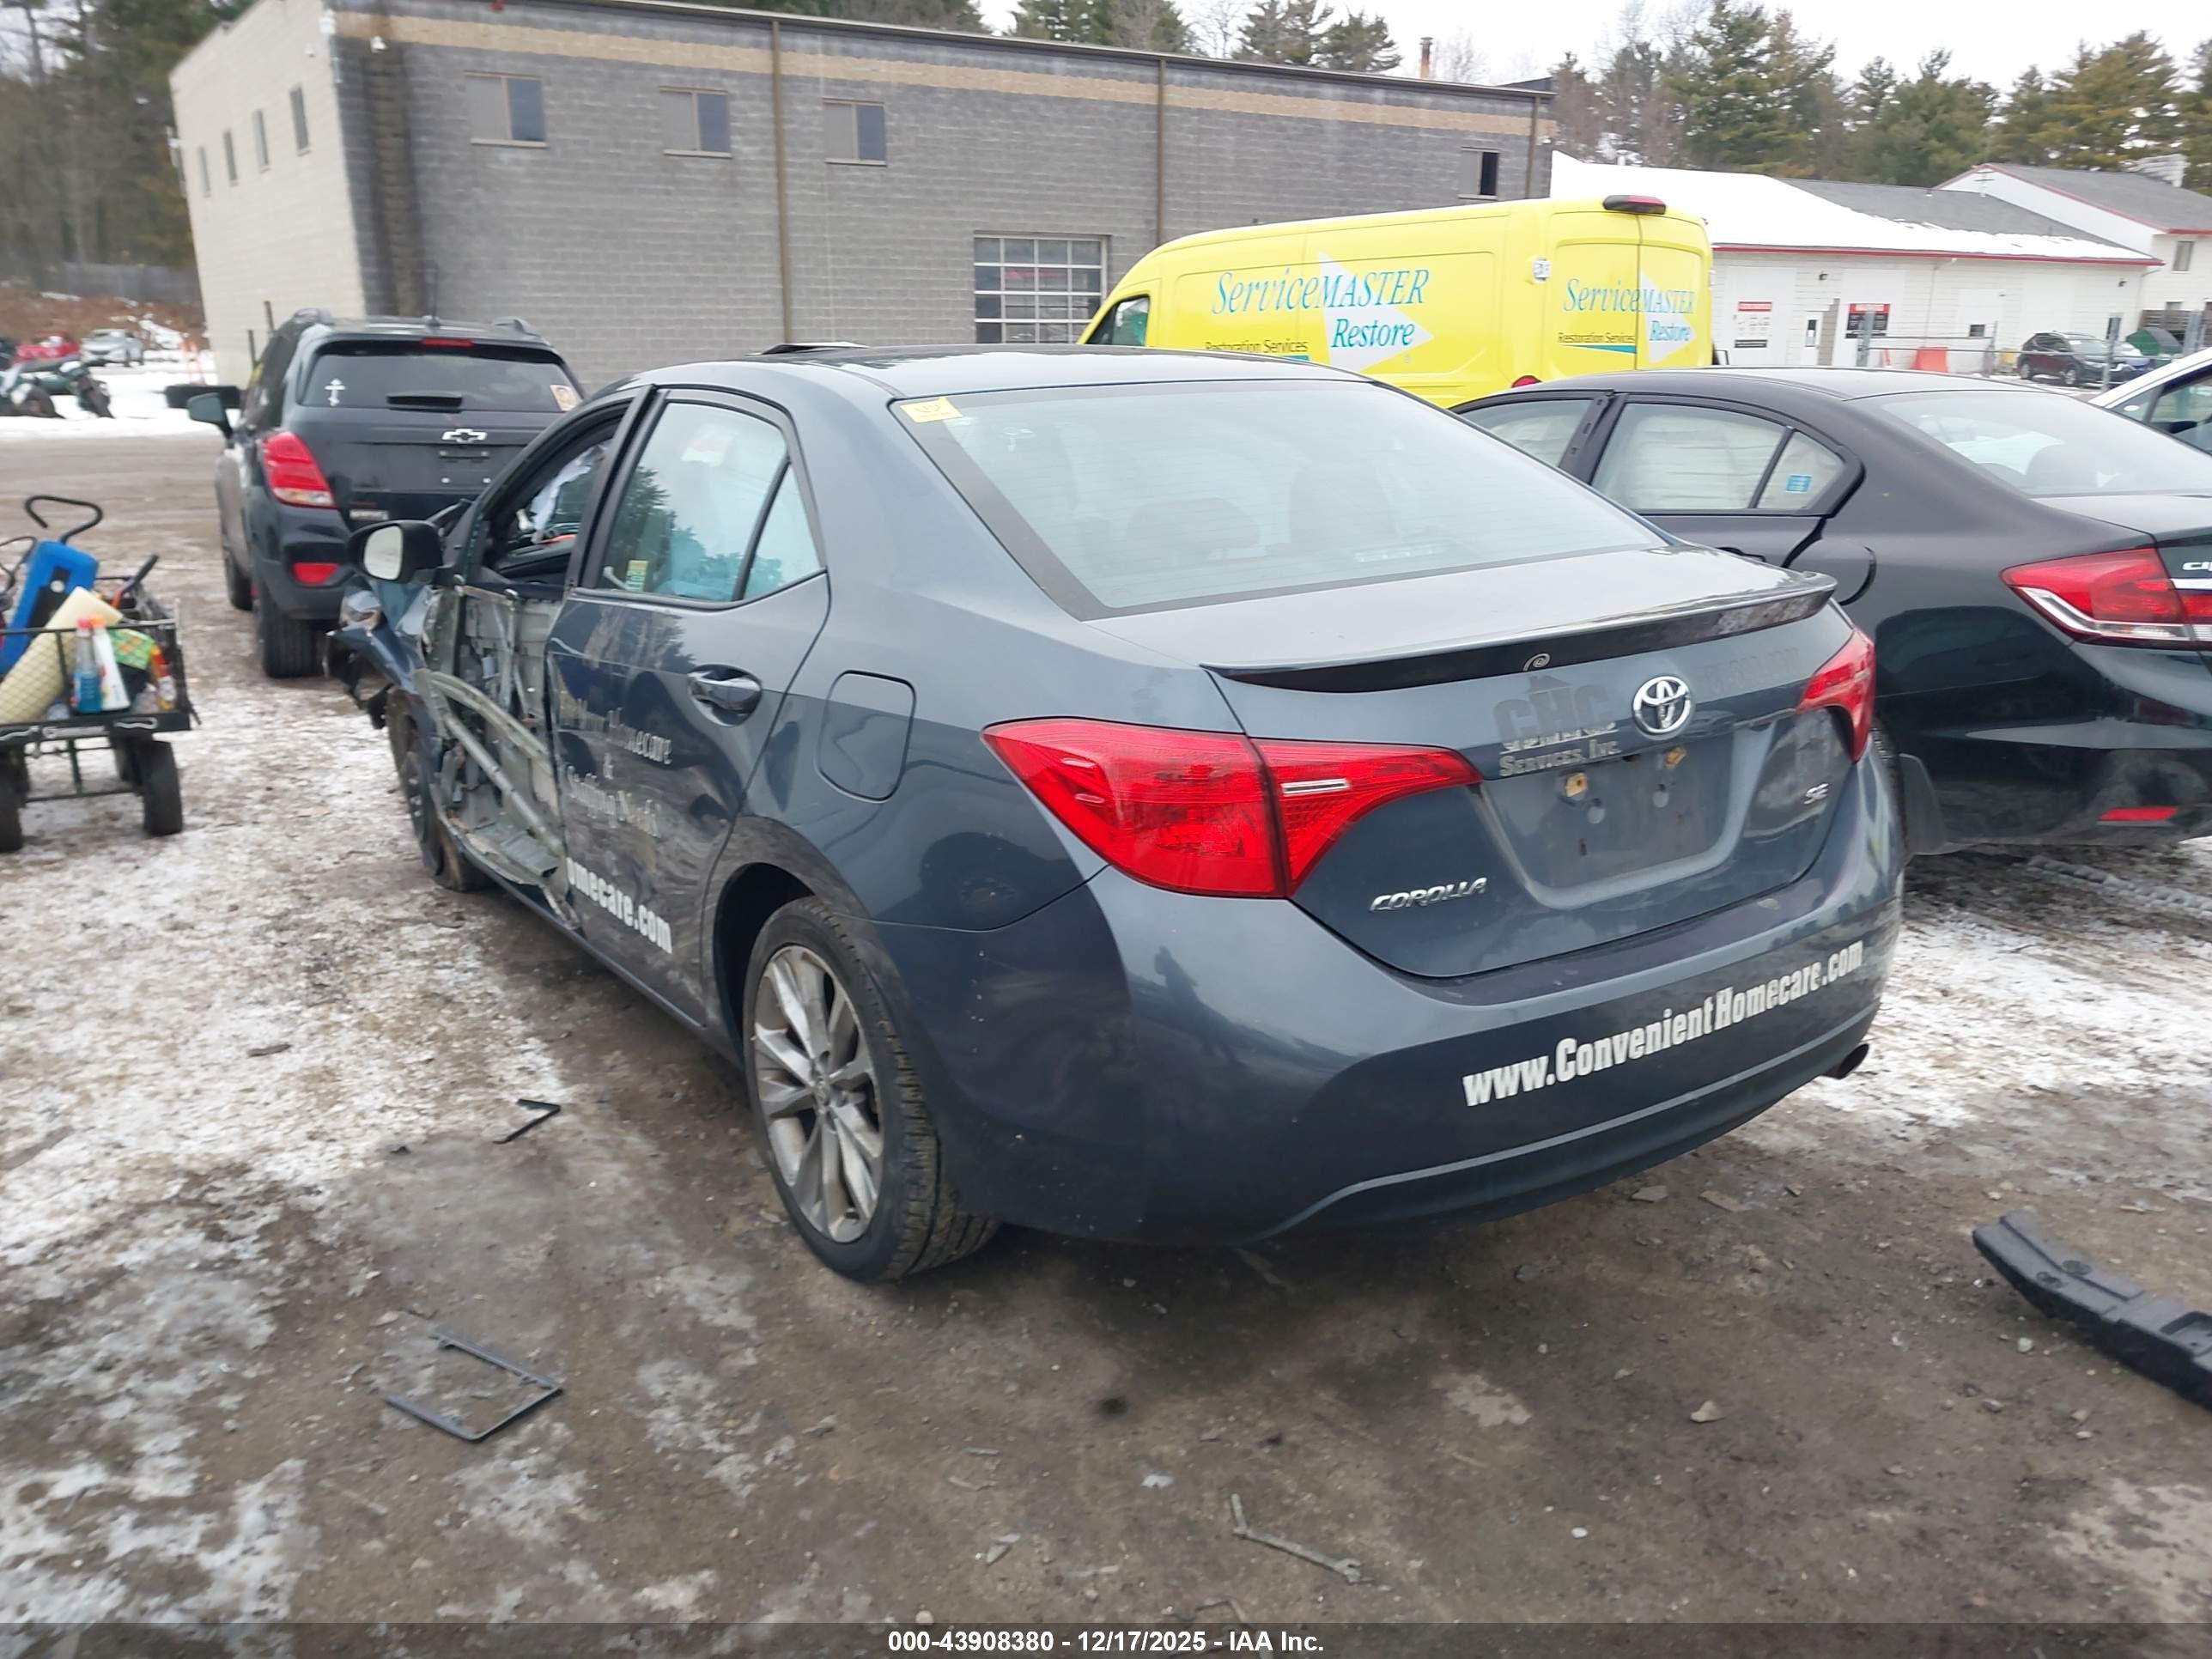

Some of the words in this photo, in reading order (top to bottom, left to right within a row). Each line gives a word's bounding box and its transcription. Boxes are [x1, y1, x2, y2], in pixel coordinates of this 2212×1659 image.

[1263, 337, 1309, 353] Services
[1330, 319, 1415, 348] Restore
[1803, 783, 1830, 805] SE
[1370, 877, 1488, 912] COROLLA
[1462, 939, 1863, 1107] www.ConvenientHomecare.com
